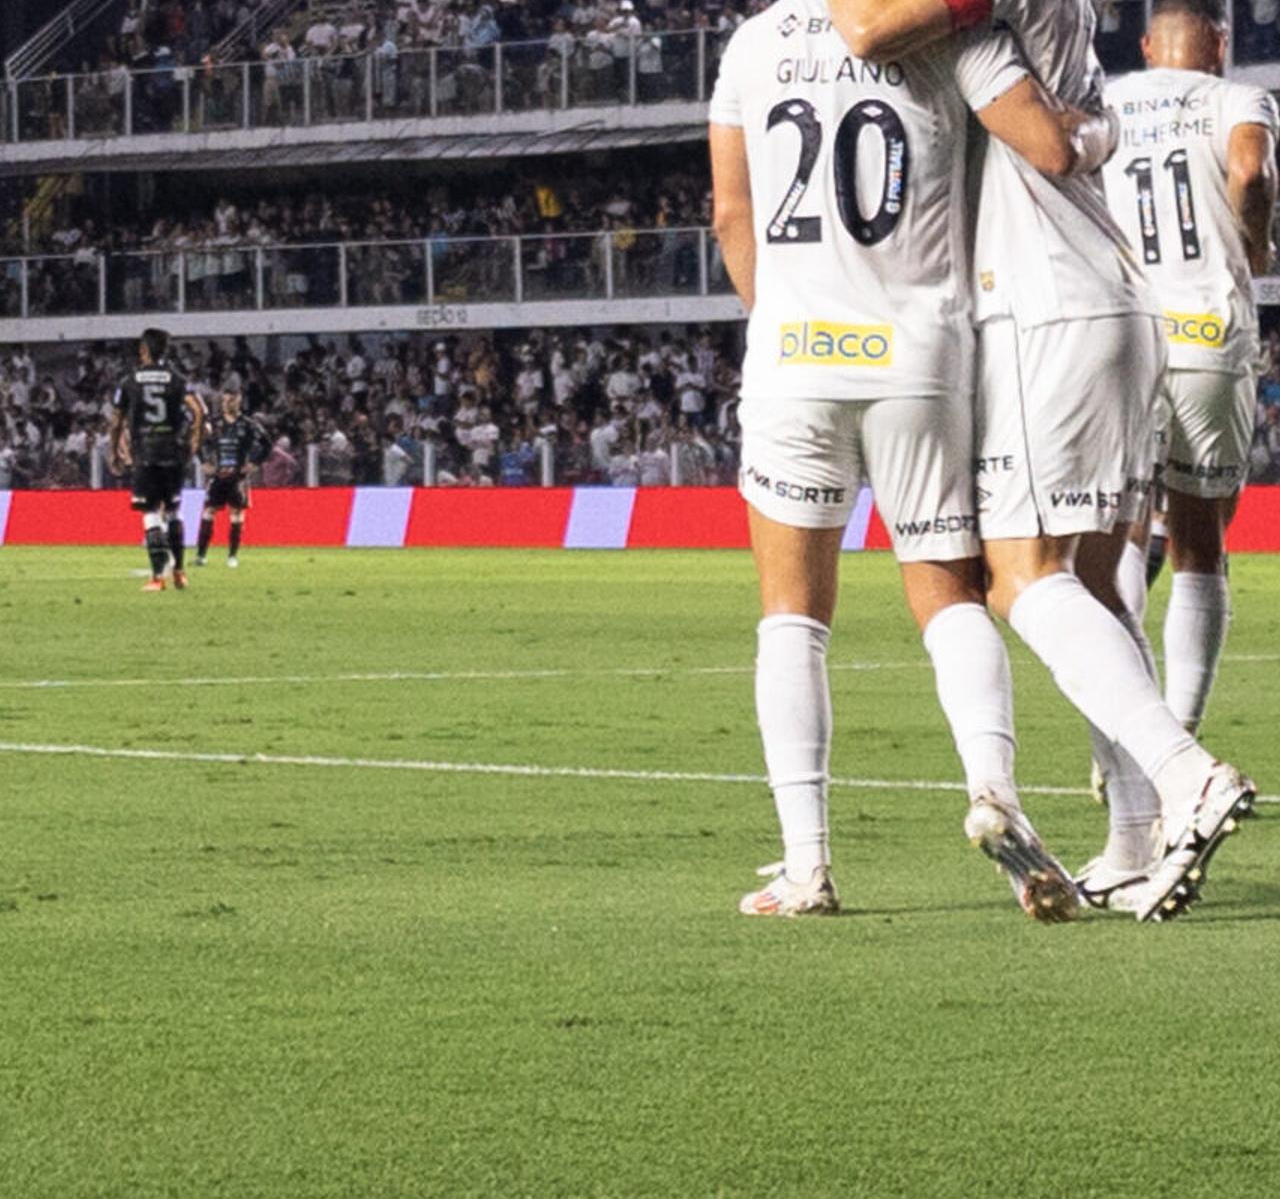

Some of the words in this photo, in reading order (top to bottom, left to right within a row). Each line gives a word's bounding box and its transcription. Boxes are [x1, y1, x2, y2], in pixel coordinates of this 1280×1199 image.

[766, 97, 909, 248] 20
[1124, 148, 1201, 265] 11
[780, 320, 889, 364] placo
[143, 384, 166, 423] 5
[776, 481, 846, 503] SORTE
